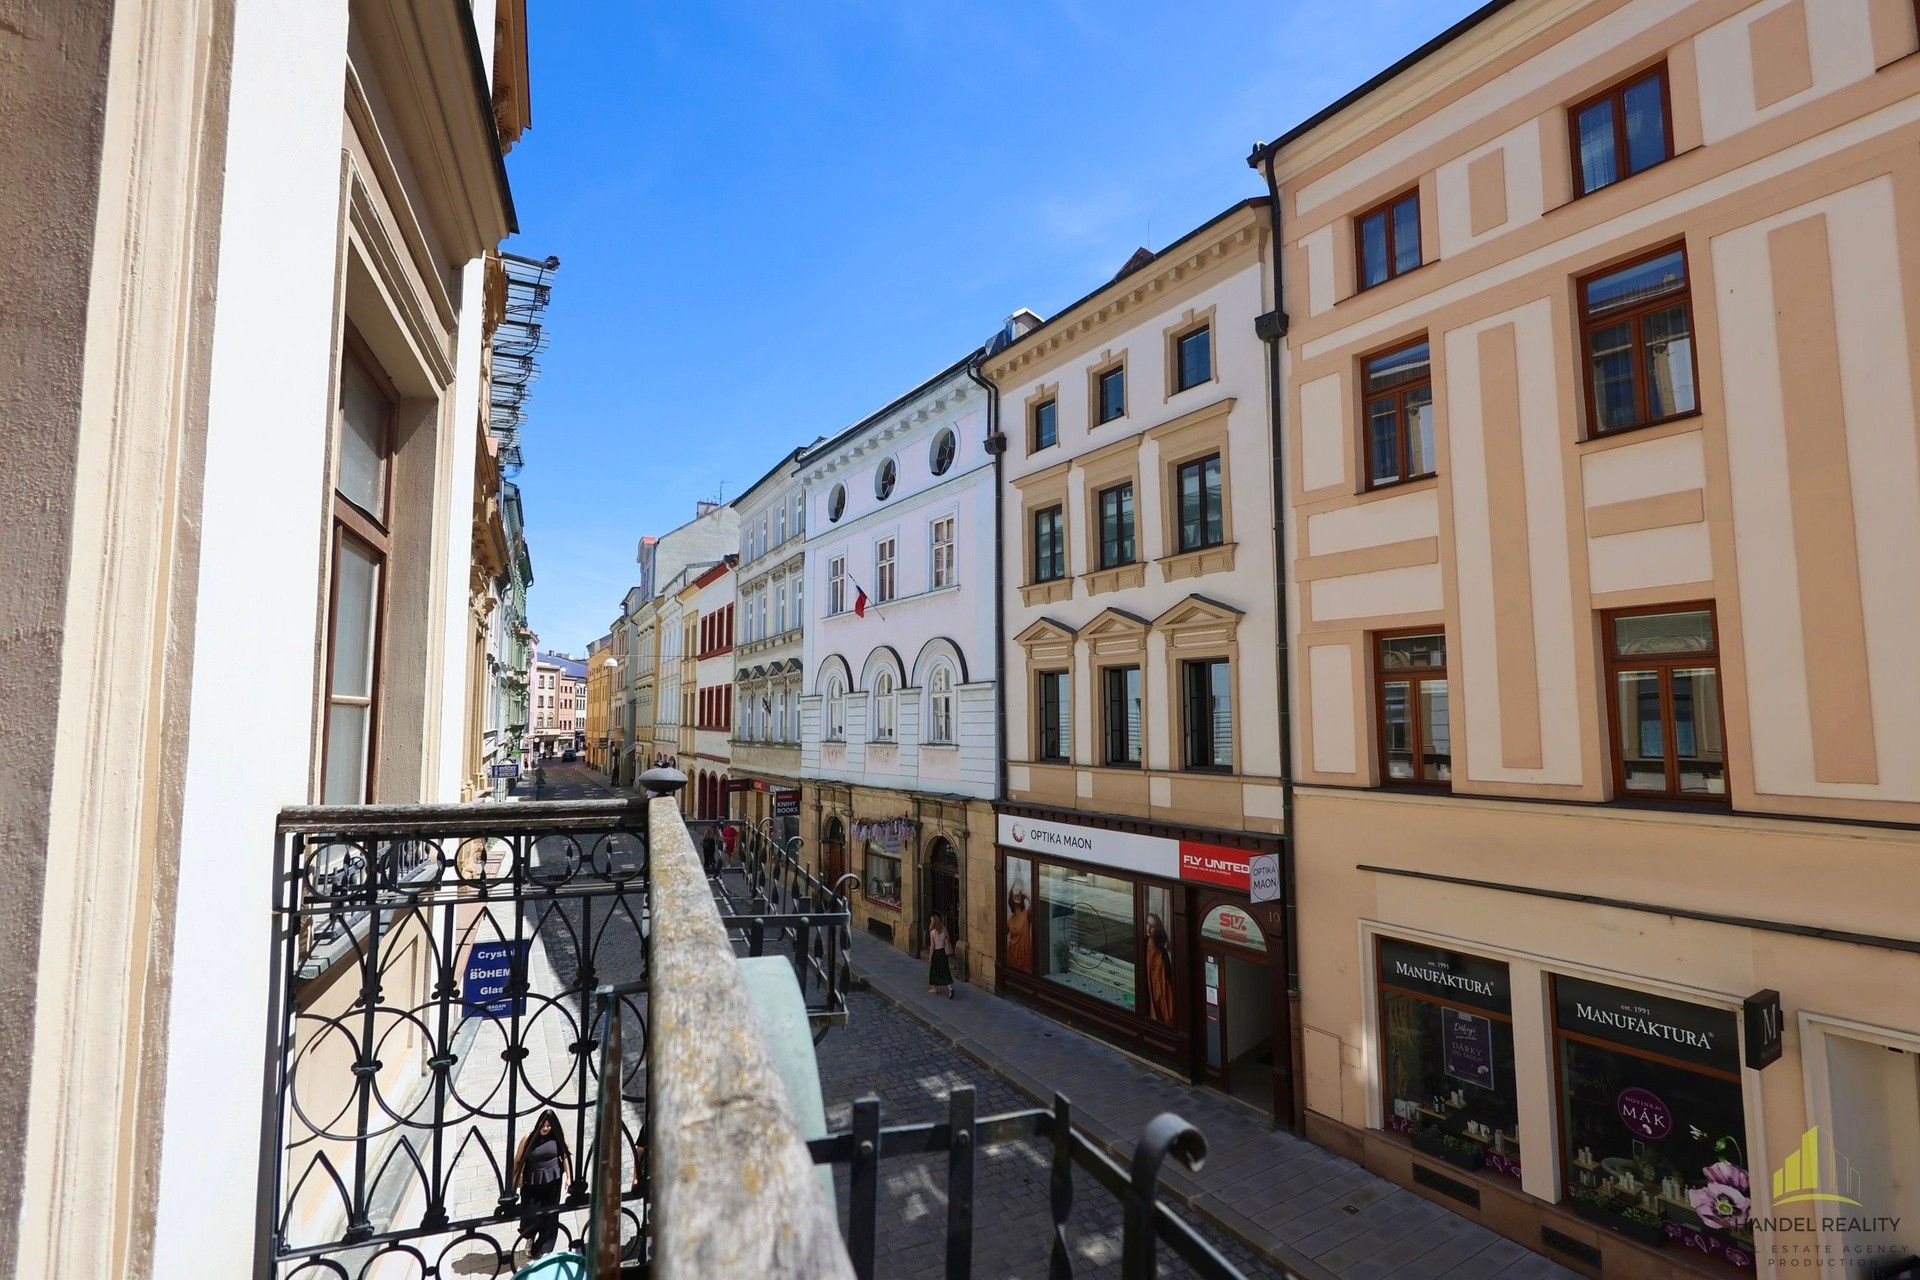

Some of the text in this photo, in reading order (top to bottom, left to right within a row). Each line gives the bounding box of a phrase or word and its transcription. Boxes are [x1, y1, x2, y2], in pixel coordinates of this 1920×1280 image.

[1031, 830, 1092, 849] OPTIKA MAON
[1183, 855, 1203, 866] FLY
[1253, 866, 1276, 877] OPTIKA
[1253, 878, 1277, 890] MAON
[478, 949, 516, 960] Crystl
[1437, 961, 1450, 970] 1991
[470, 968, 511, 980] BOHEM
[480, 987, 504, 995] Glas
[1620, 1004, 1650, 1016] est. 1991
[1622, 1104, 1666, 1129] MÁK
